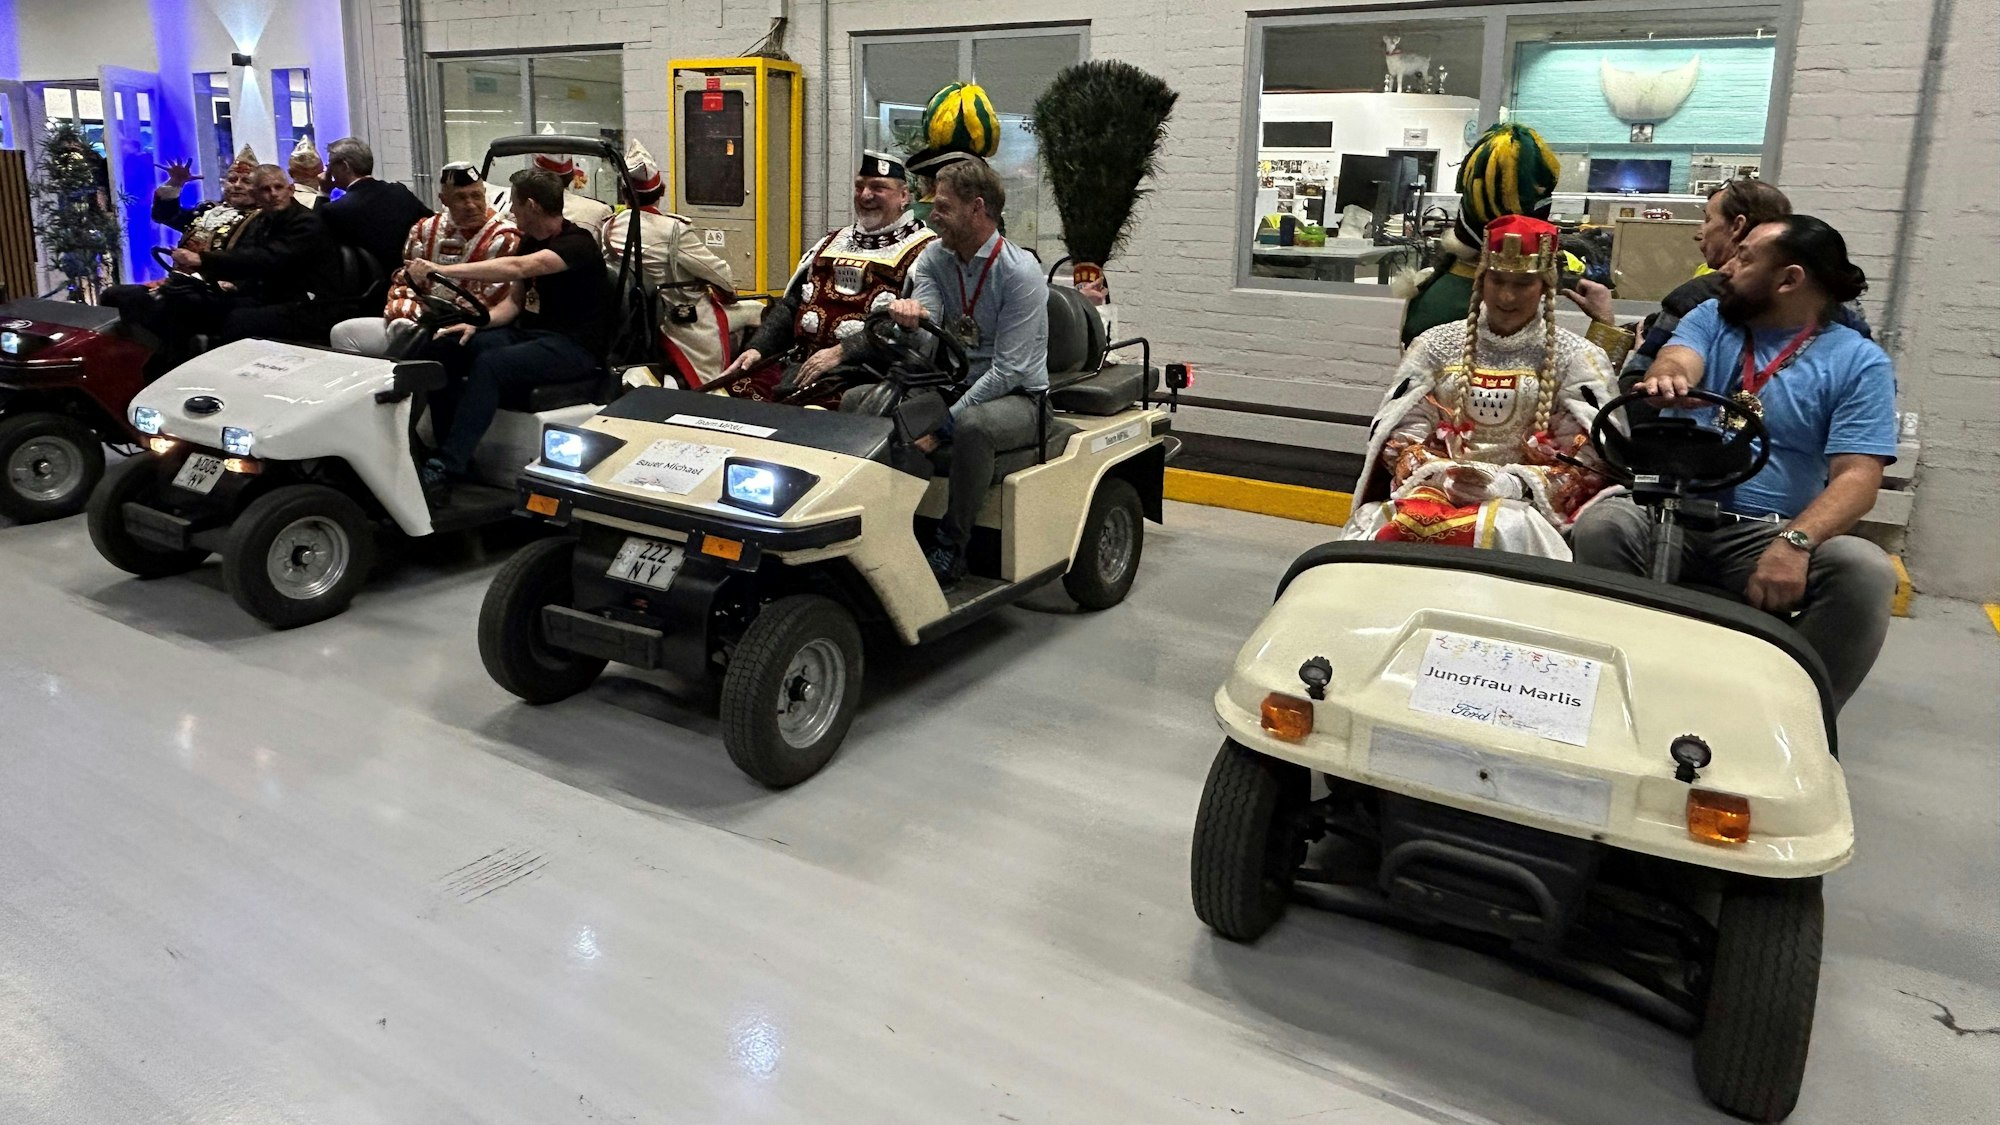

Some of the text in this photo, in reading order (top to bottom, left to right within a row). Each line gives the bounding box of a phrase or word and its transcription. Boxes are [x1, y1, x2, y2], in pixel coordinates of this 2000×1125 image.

[663, 462, 705, 475] Michael
[639, 542, 673, 564] 222
[1424, 666, 1582, 708] Jungfrau Marlis
[1451, 703, 1490, 721] Ford
